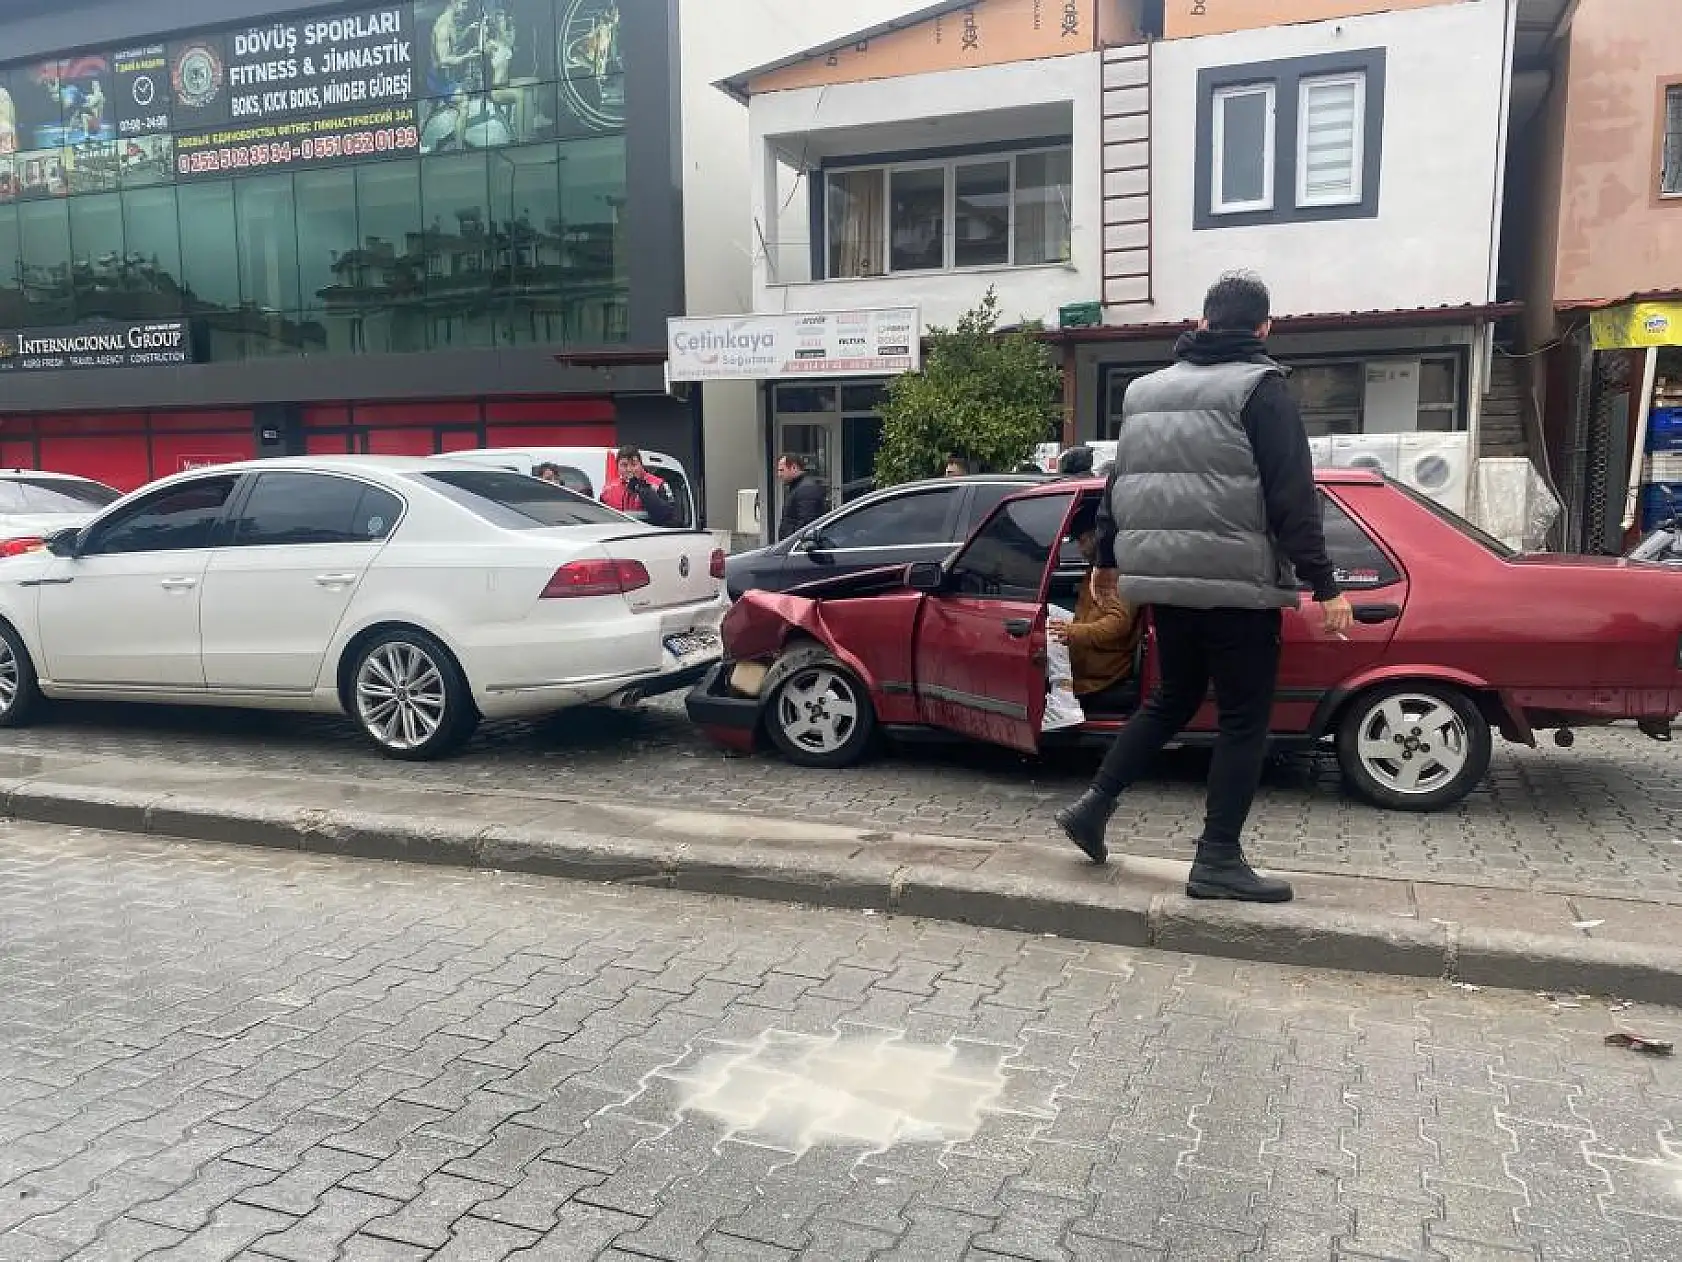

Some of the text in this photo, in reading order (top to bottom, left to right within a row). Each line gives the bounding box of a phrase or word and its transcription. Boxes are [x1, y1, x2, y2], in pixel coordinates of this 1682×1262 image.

[235, 10, 400, 55] DÖVÜŞ SPORLARI
[230, 59, 297, 86] FITNESS
[303, 56, 315, 75] &
[322, 38, 411, 72] JİMNASTİK
[231, 68, 411, 116] BOKS, KICK BOKS, MİNDER GÜREŞİ
[17, 326, 182, 354] INTERNACIONAL GROUP
[675, 326, 775, 355] Çetinkaya
